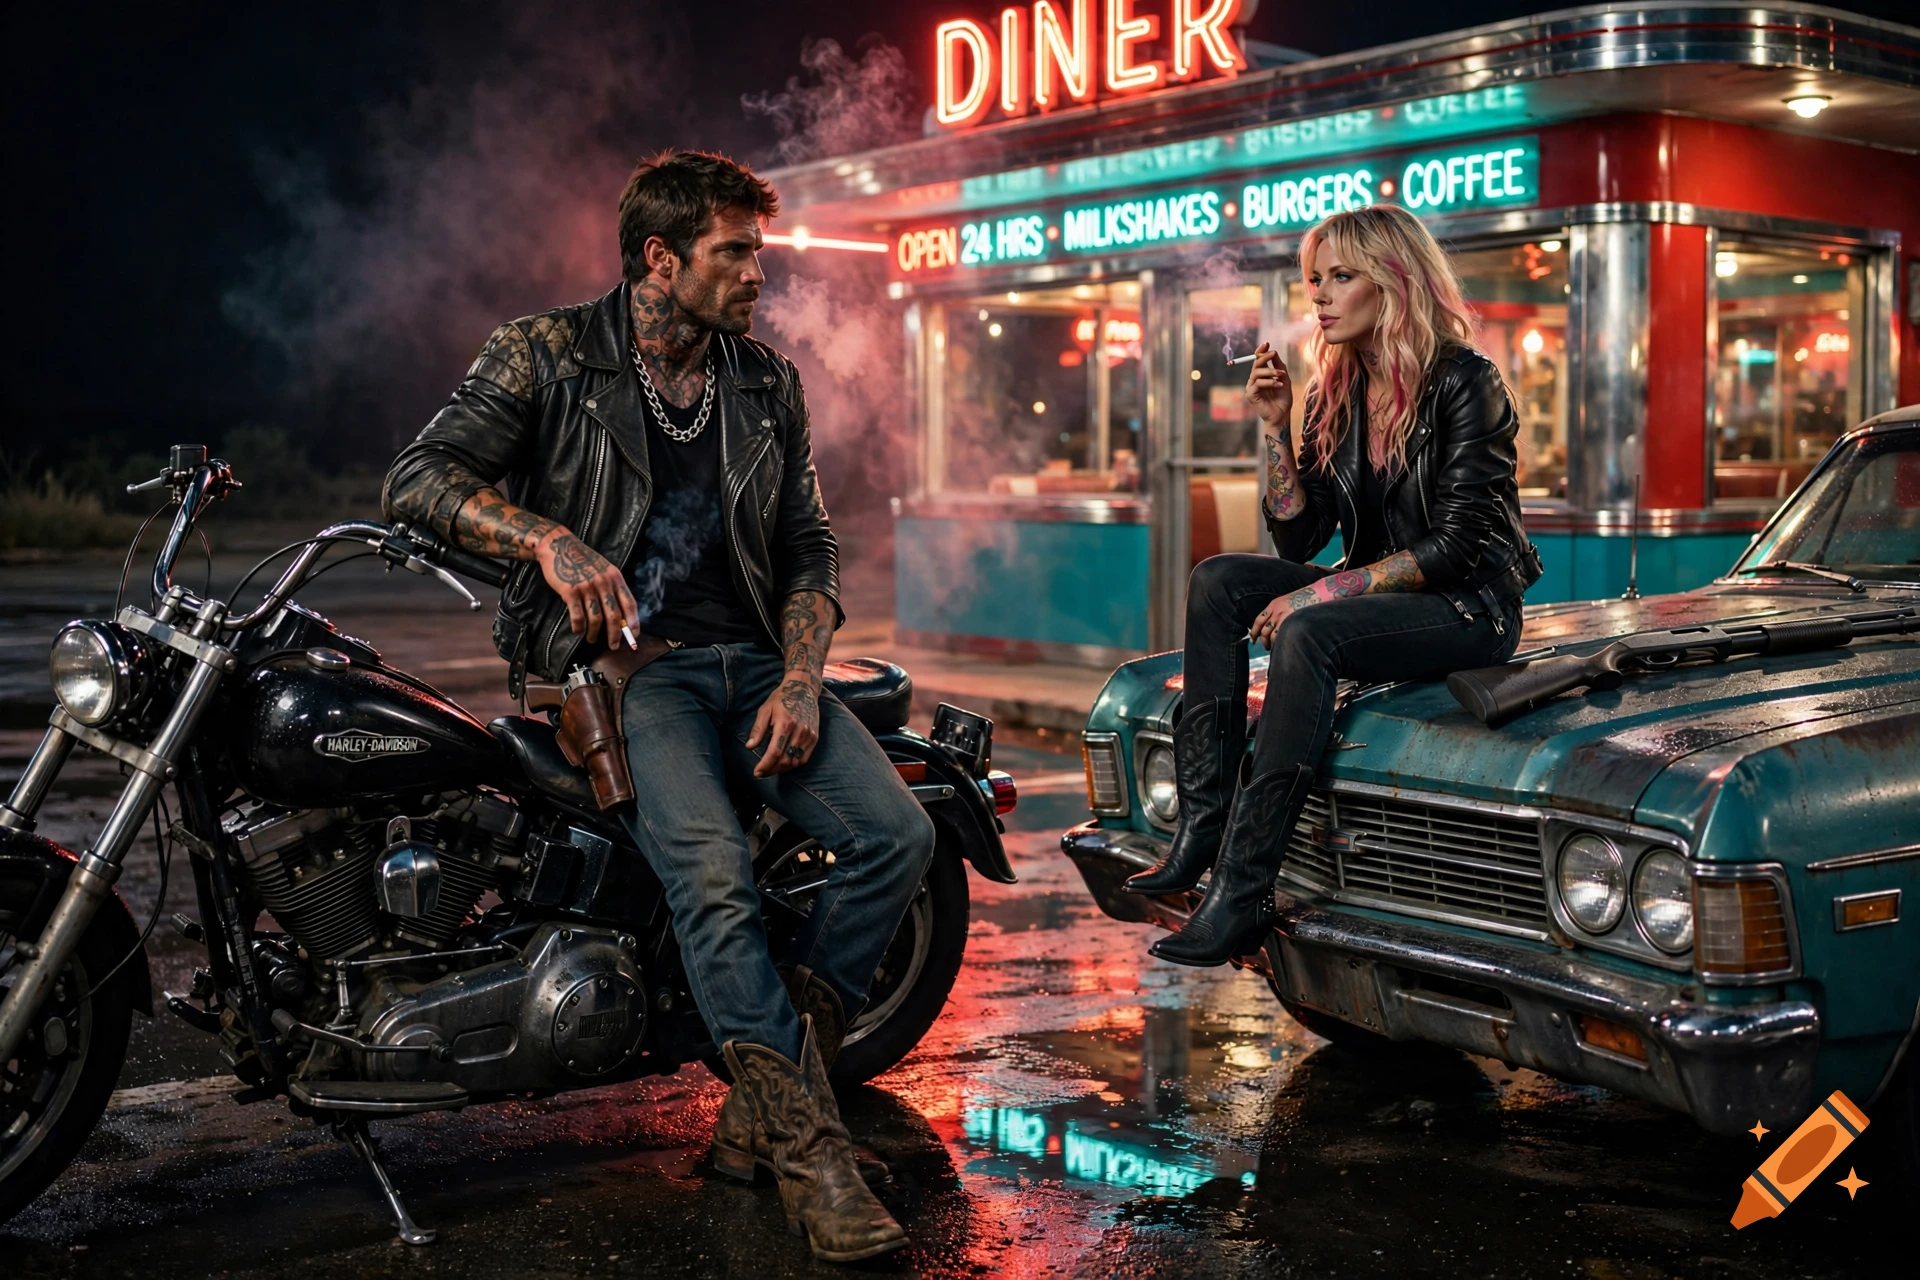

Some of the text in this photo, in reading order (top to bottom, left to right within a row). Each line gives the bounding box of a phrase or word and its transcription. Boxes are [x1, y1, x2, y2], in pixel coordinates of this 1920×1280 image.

[936, 0, 1247, 124] DINER
[897, 148, 1525, 272] OPEN 24 HRS MILKSHAKES BURGERS COFFEE
[326, 738, 418, 753] HARLEY-DAVIDSON
